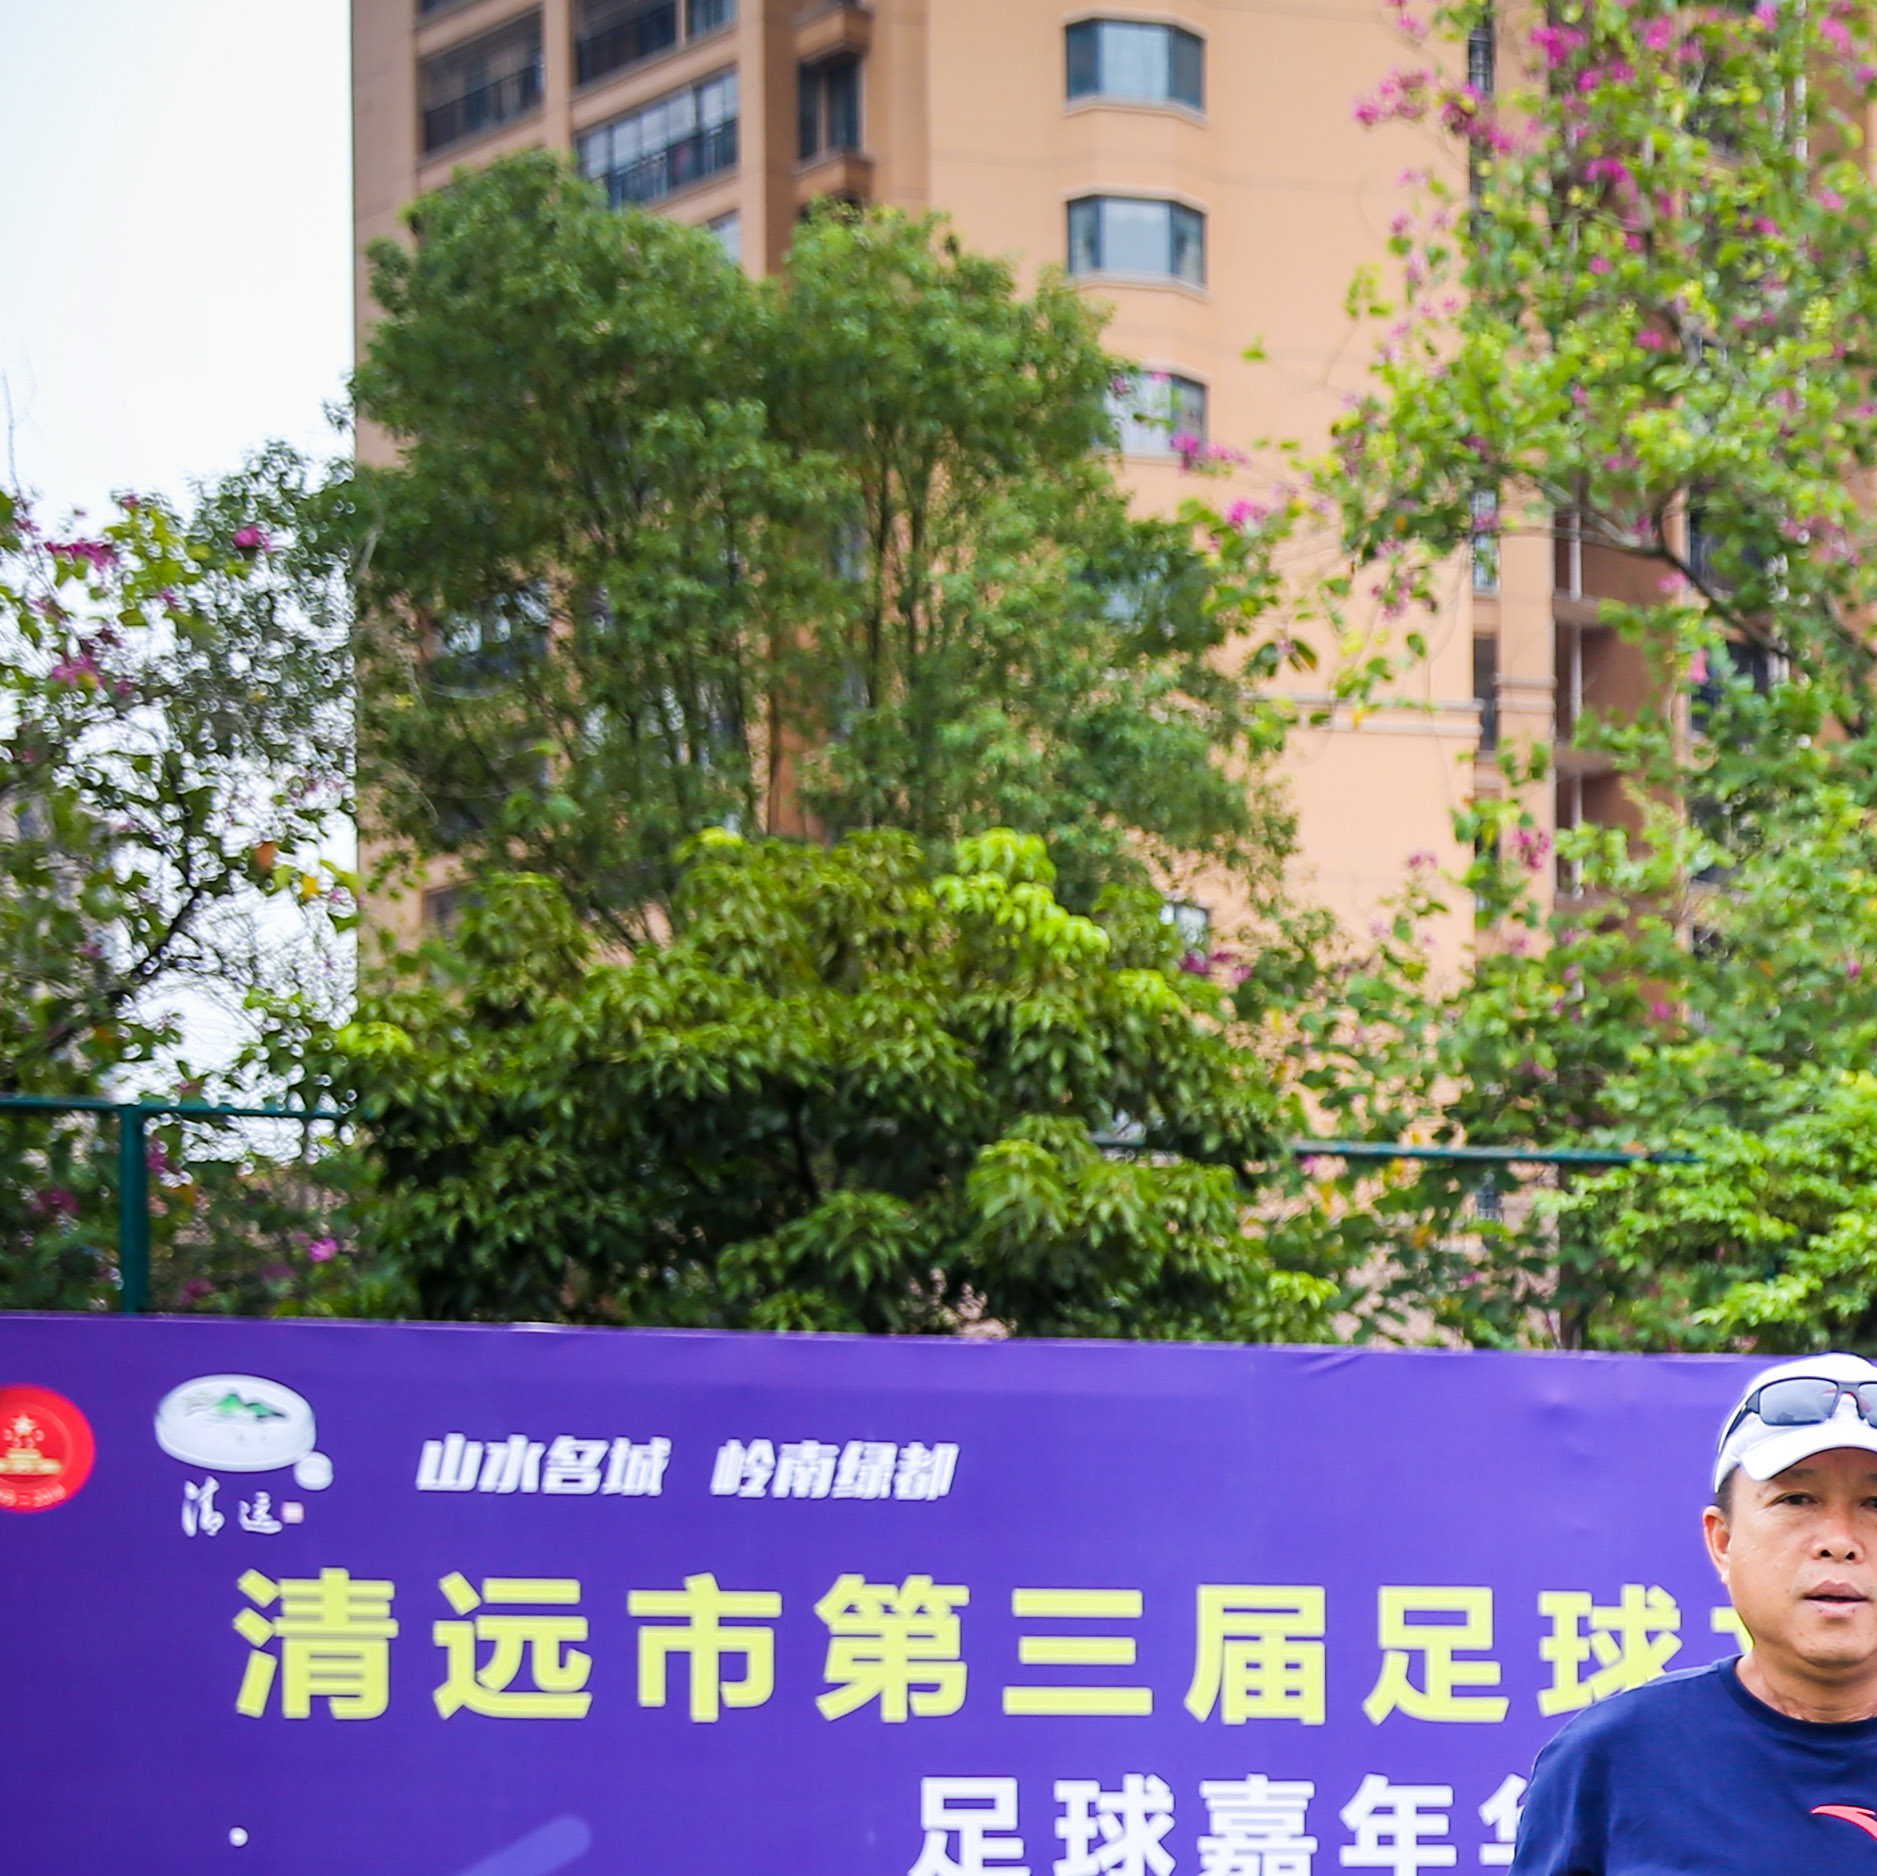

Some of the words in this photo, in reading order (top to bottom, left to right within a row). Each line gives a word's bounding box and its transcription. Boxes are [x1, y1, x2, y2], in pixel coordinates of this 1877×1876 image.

[416, 1432, 672, 1497] 山水名城
[710, 1438, 960, 1502] 岭南绿都
